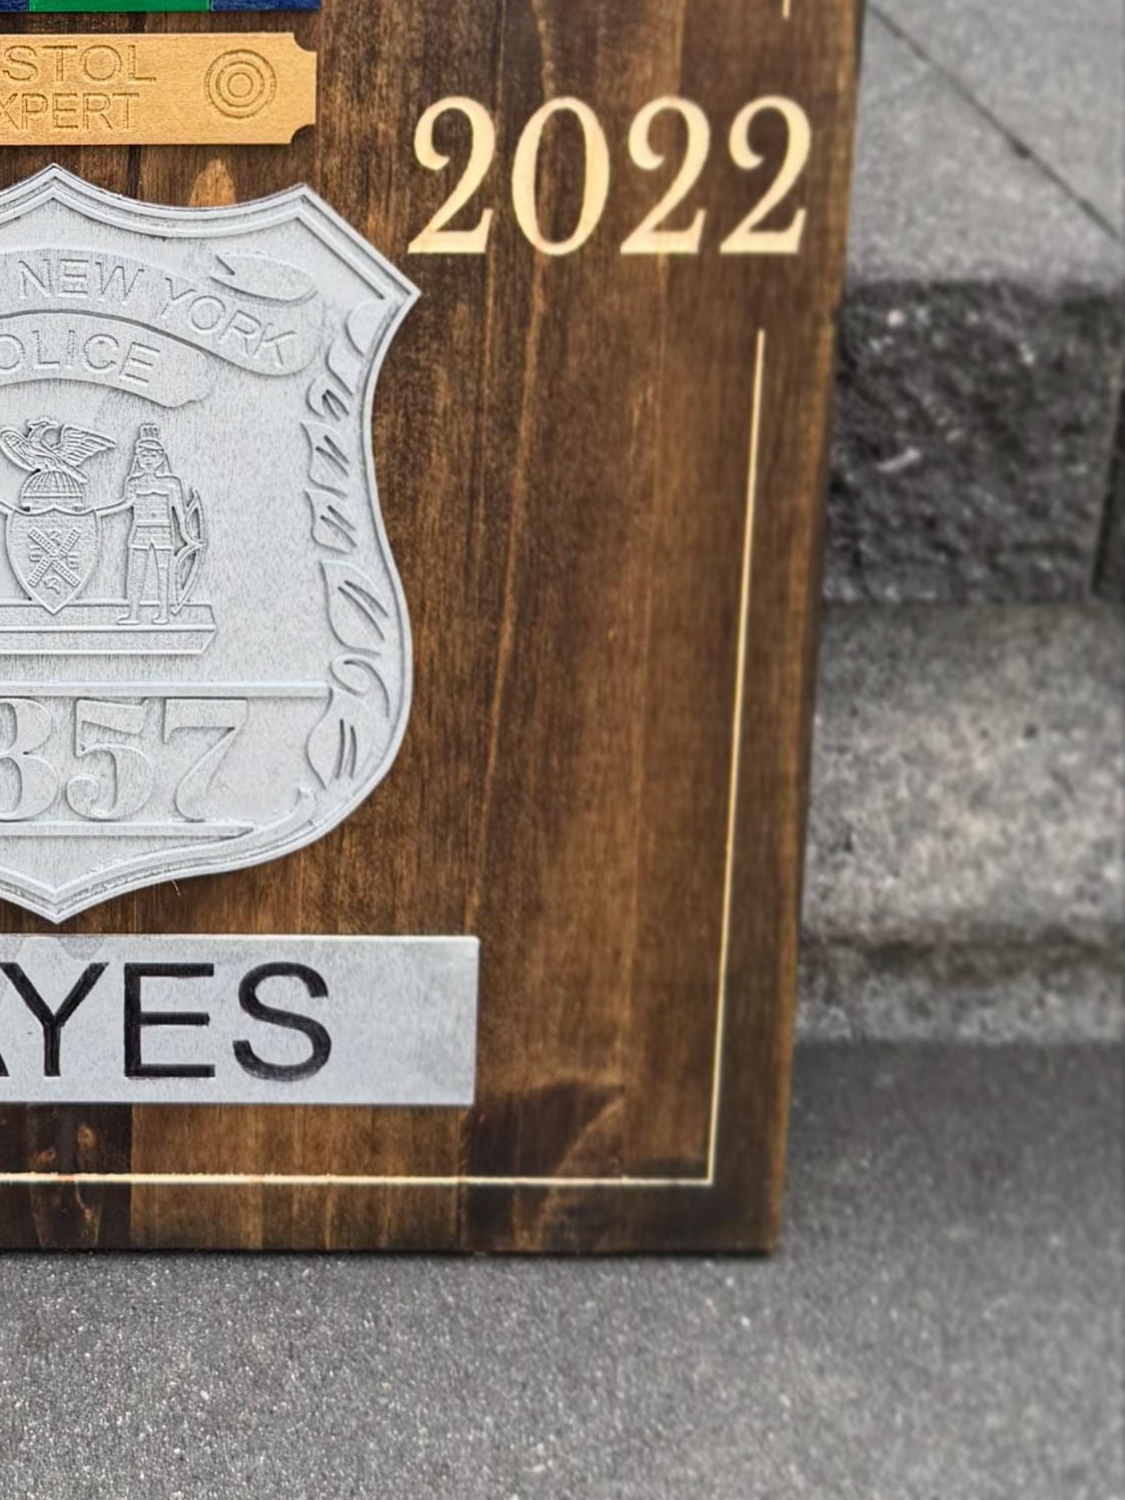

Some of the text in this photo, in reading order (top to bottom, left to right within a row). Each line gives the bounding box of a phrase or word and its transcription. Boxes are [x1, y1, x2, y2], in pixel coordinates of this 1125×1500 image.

[407, 95, 811, 255] 2022
[18, 259, 145, 303] NEW
[162, 277, 299, 369] YORK
